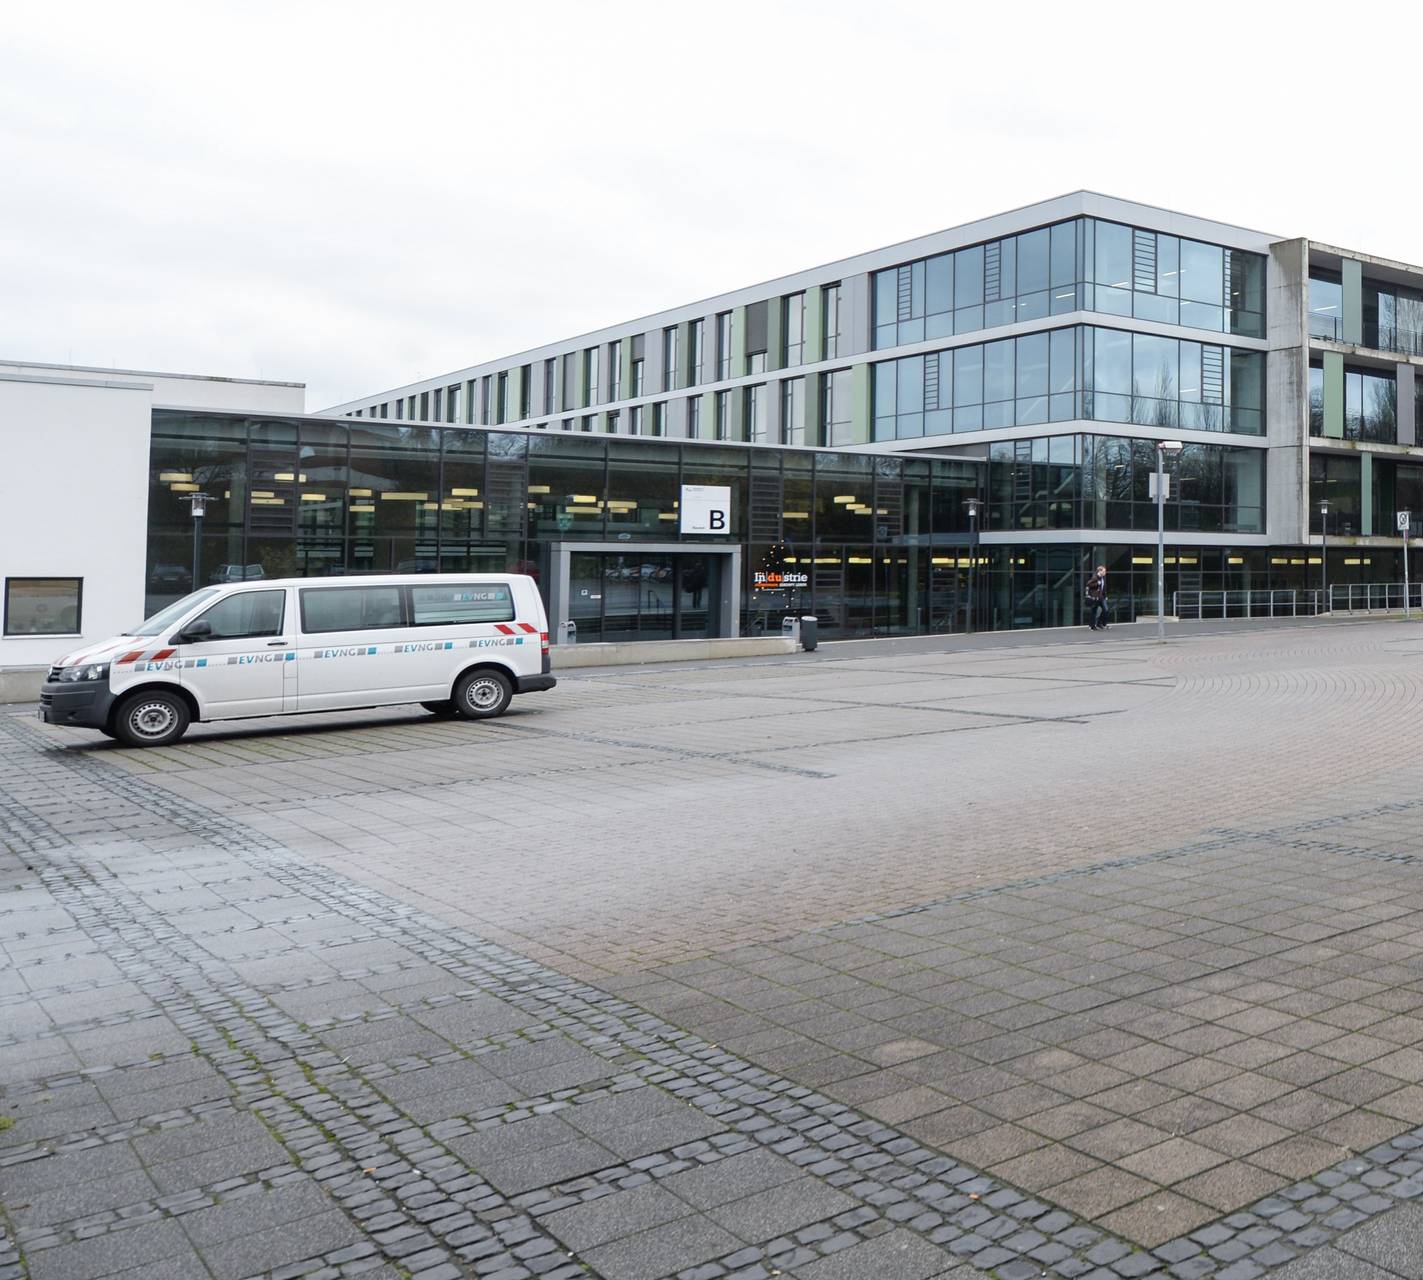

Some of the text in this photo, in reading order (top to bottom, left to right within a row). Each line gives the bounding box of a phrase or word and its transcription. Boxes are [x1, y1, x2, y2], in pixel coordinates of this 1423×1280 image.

[710, 510, 725, 529] B
[404, 642, 434, 653] EVNG
[478, 638, 507, 648] EVNG
[239, 652, 272, 665] EVNG
[324, 648, 356, 659] EVNG
[146, 660, 183, 672] EVNG
